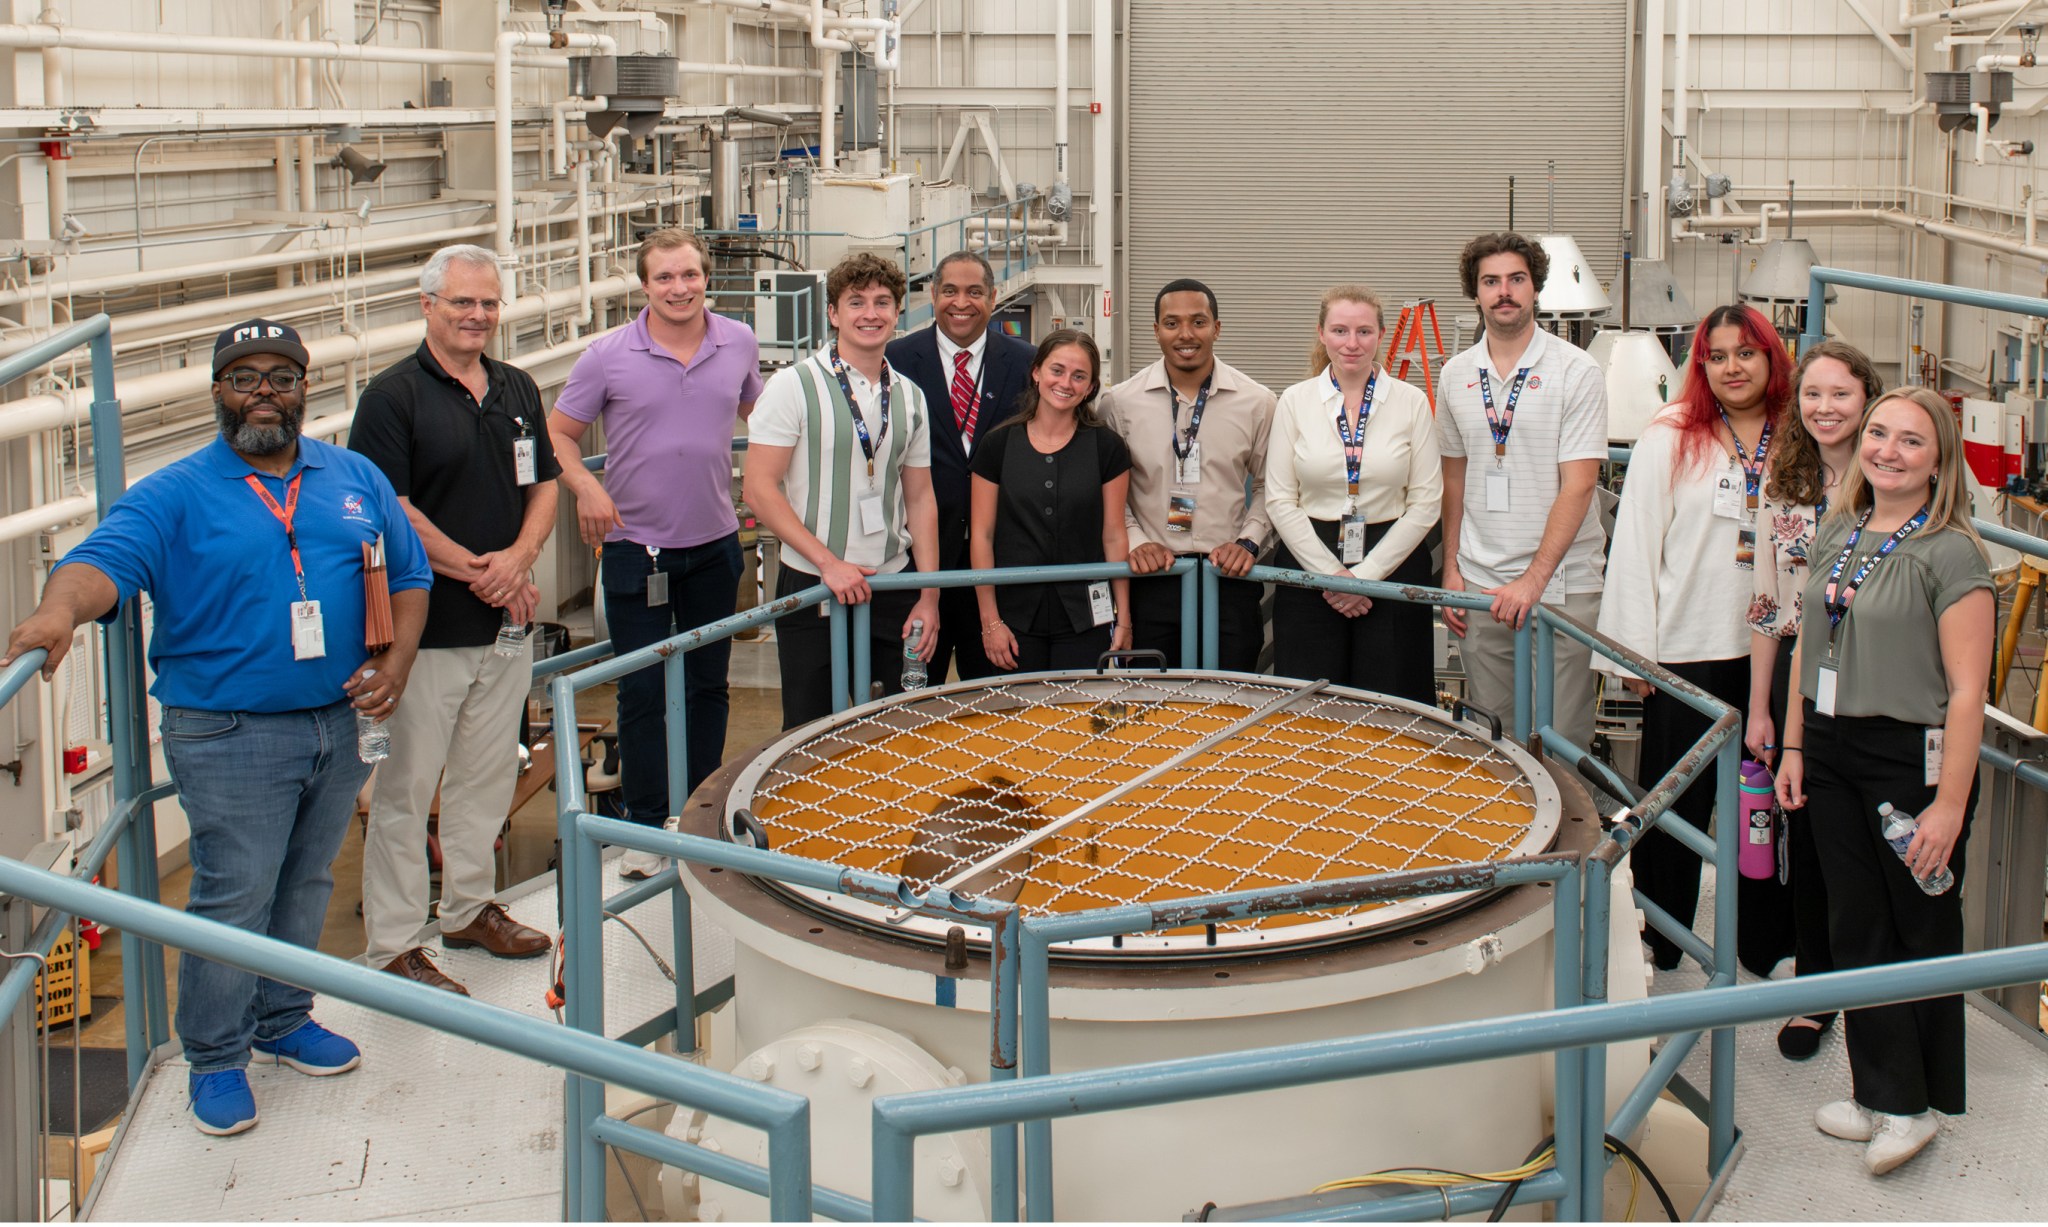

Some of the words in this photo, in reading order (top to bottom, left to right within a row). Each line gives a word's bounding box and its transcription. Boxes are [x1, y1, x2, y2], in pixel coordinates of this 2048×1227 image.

[1364, 384, 1374, 401] USA
[1482, 376, 1492, 404] NASA
[1508, 380, 1523, 406] NASA
[1340, 418, 1351, 443] NASA
[1356, 417, 1367, 442] NASA
[1757, 434, 1771, 457] NASA
[1896, 519, 1920, 538] USA
[1832, 549, 1852, 578] NASA
[1855, 555, 1881, 585] NASA
